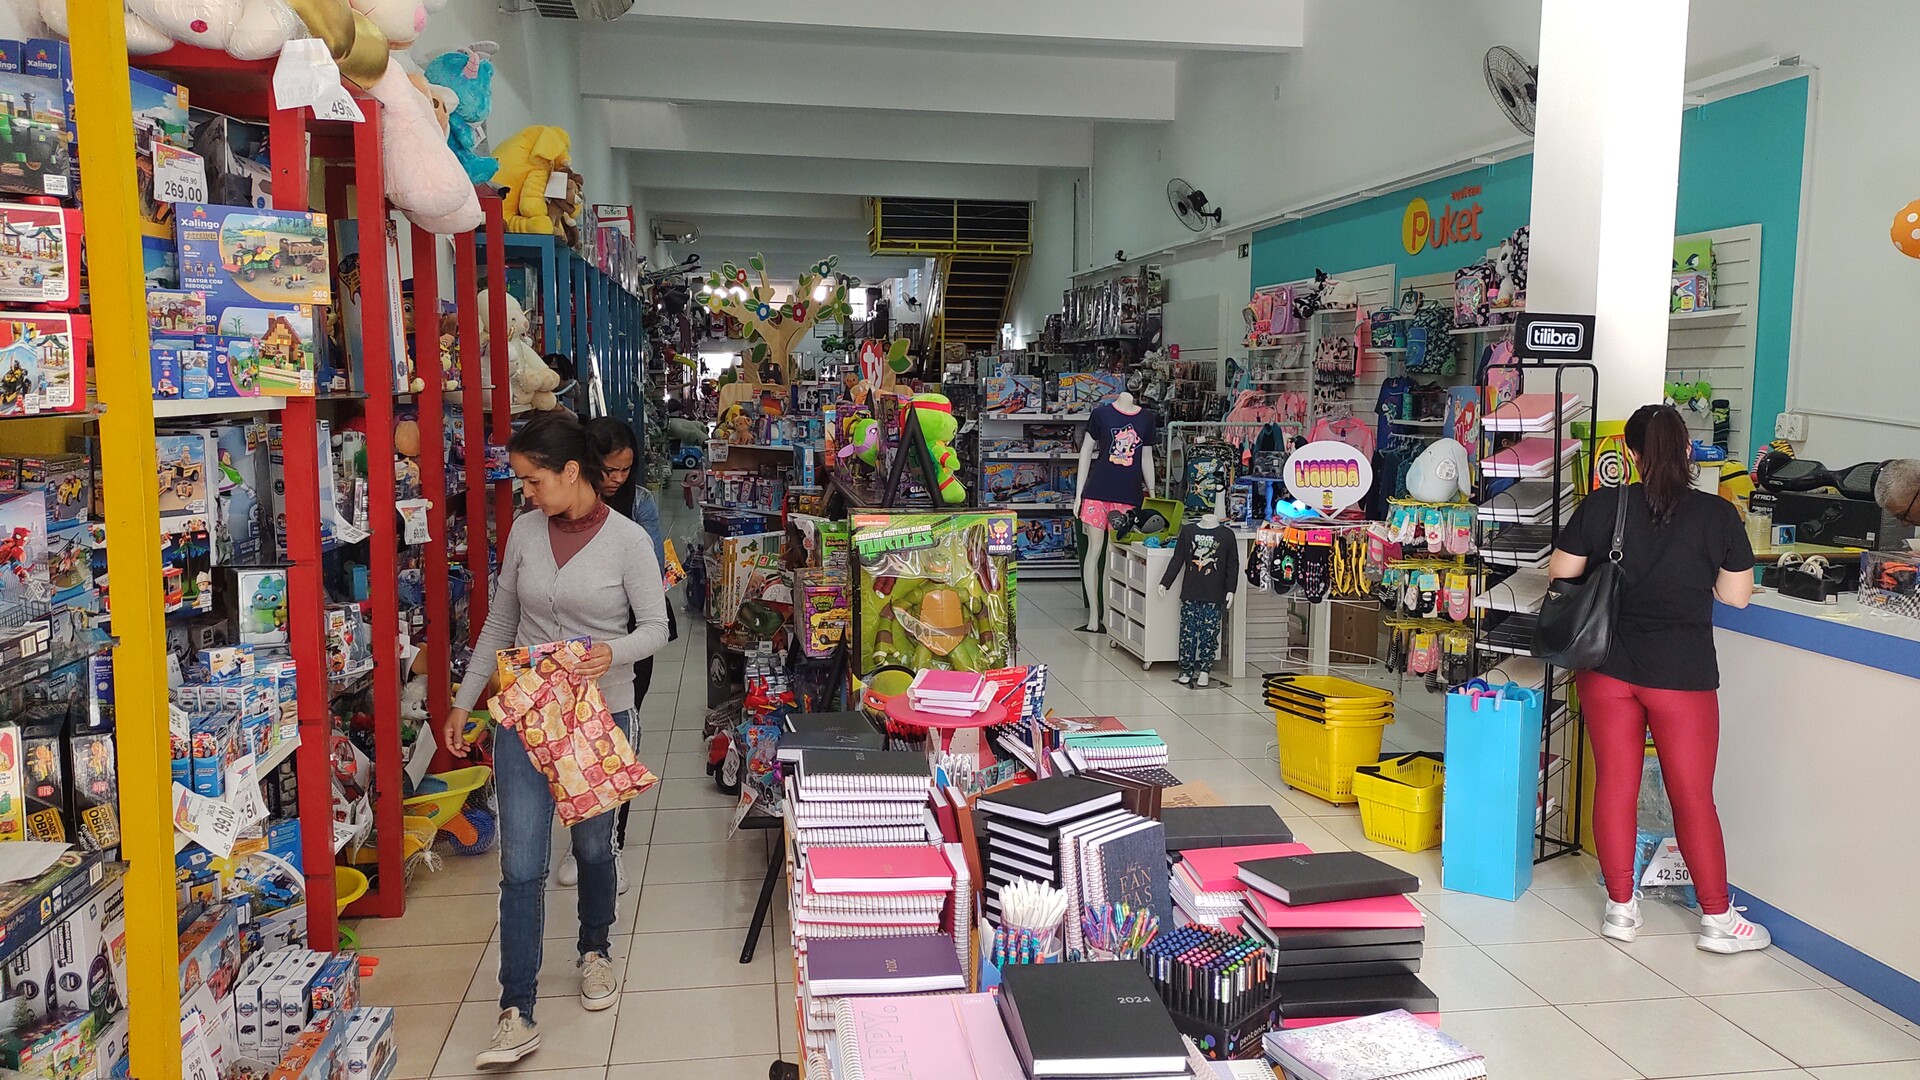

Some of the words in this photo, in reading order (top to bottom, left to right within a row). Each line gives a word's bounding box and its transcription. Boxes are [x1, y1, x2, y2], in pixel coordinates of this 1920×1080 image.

[0, 61, 17, 70] ingo
[27, 59, 58, 70] Xalingo
[179, 175, 198, 185] 449,90
[164, 181, 202, 202] 269,00
[180, 218, 220, 229] Xalingo
[1411, 202, 1483, 250] Puket
[184, 277, 208, 285] TRATOR
[312, 290, 328, 298] 260
[1533, 328, 1577, 345] tilibra
[863, 344, 883, 389] ty
[1295, 459, 1360, 488] LIQUIDA
[856, 531, 883, 541] TEENAGE
[883, 527, 911, 537] MUTANT
[856, 531, 934, 555] TURTLES
[1195, 534, 1215, 542] ROCK
[33, 814, 51, 842] OBRA
[44, 811, 56, 835] CIDADE
[88, 809, 109, 846] OBRAS
[99, 807, 113, 832] CIDADE
[213, 805, 235, 838] 199,00
[1120, 866, 1151, 893] FAN
[1656, 868, 1689, 882] 42,50
[885, 958, 898, 973] 2024
[1117, 996, 1151, 1004] 2024
[861, 1009, 912, 1080] APPY
[1239, 1023, 1266, 1047] pentonic
